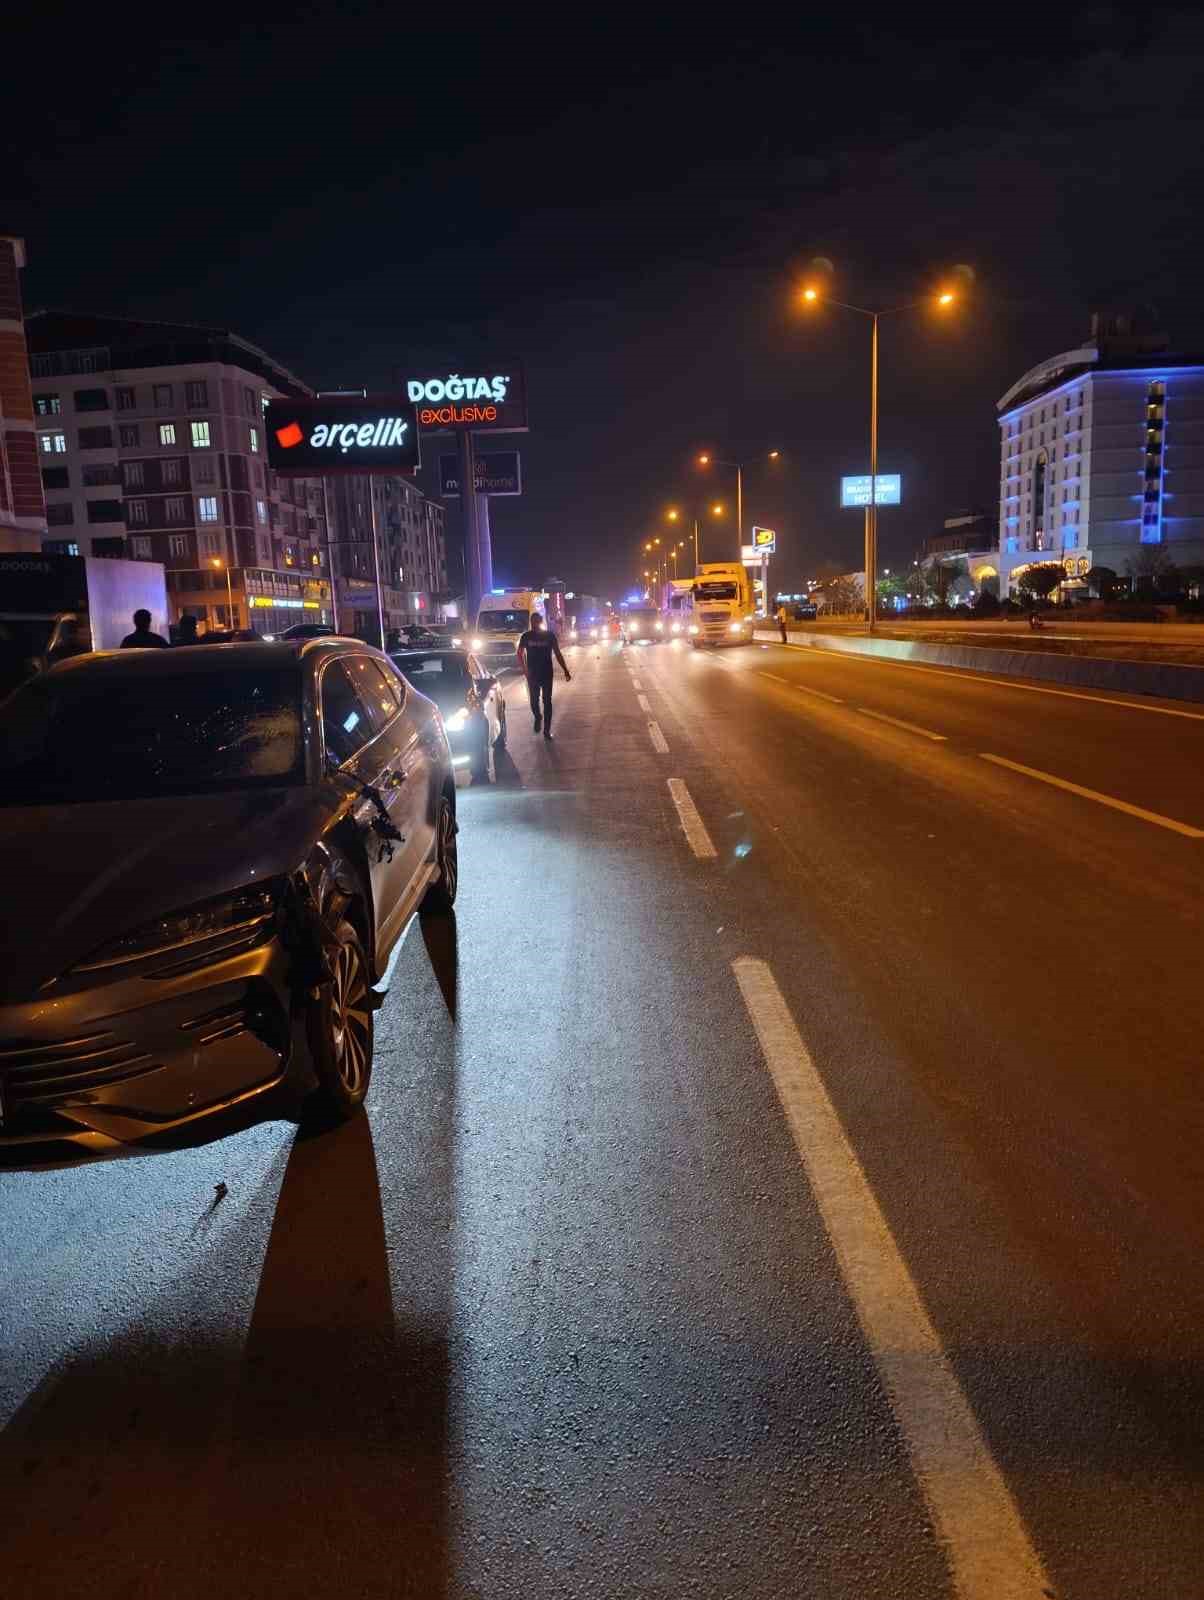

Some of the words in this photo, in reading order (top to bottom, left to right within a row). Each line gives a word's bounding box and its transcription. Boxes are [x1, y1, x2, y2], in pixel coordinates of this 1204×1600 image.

[407, 374, 508, 403] DOĞTAŞ
[421, 405, 497, 425] exclusive
[310, 417, 408, 453] arçelik
